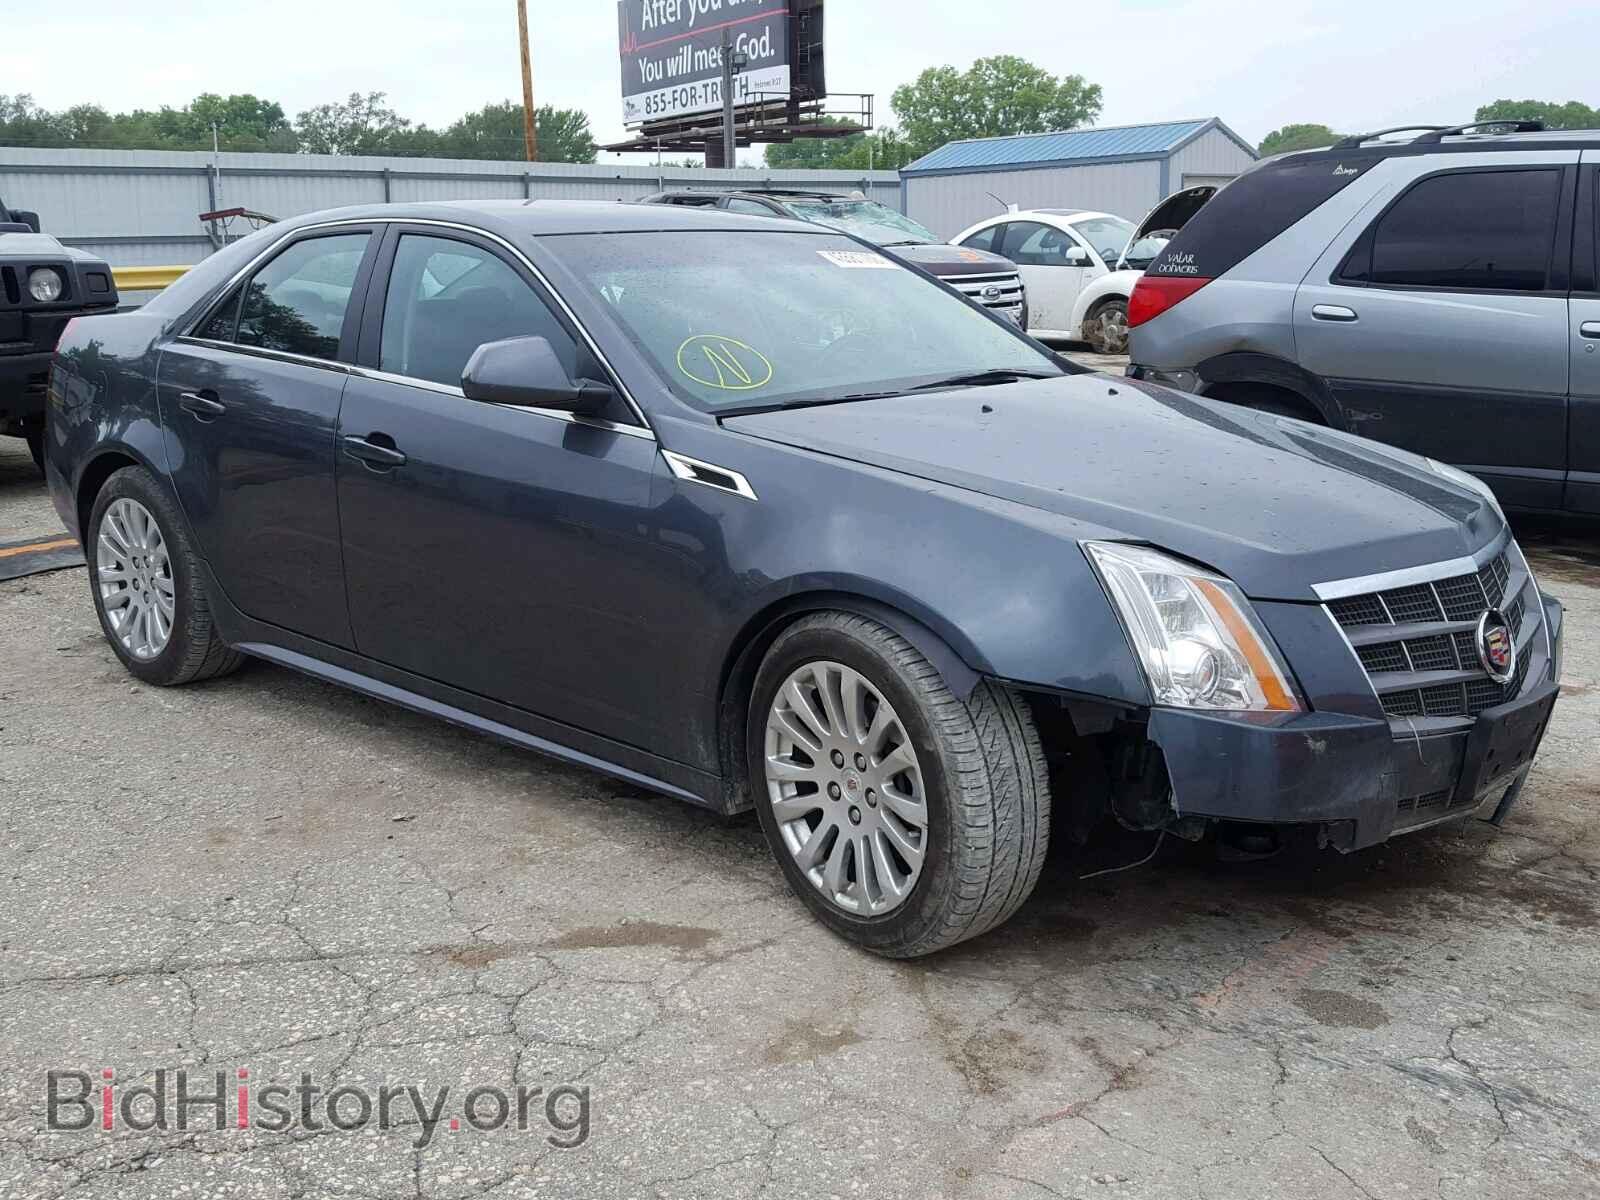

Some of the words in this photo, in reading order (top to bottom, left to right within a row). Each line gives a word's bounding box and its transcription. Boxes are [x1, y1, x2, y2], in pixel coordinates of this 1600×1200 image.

[641, 0, 682, 31] After
[638, 57, 663, 84] You
[667, 45, 692, 78] will
[694, 42, 733, 73] mee
[736, 26, 775, 62] God.
[1167, 251, 1195, 264] VALAR
